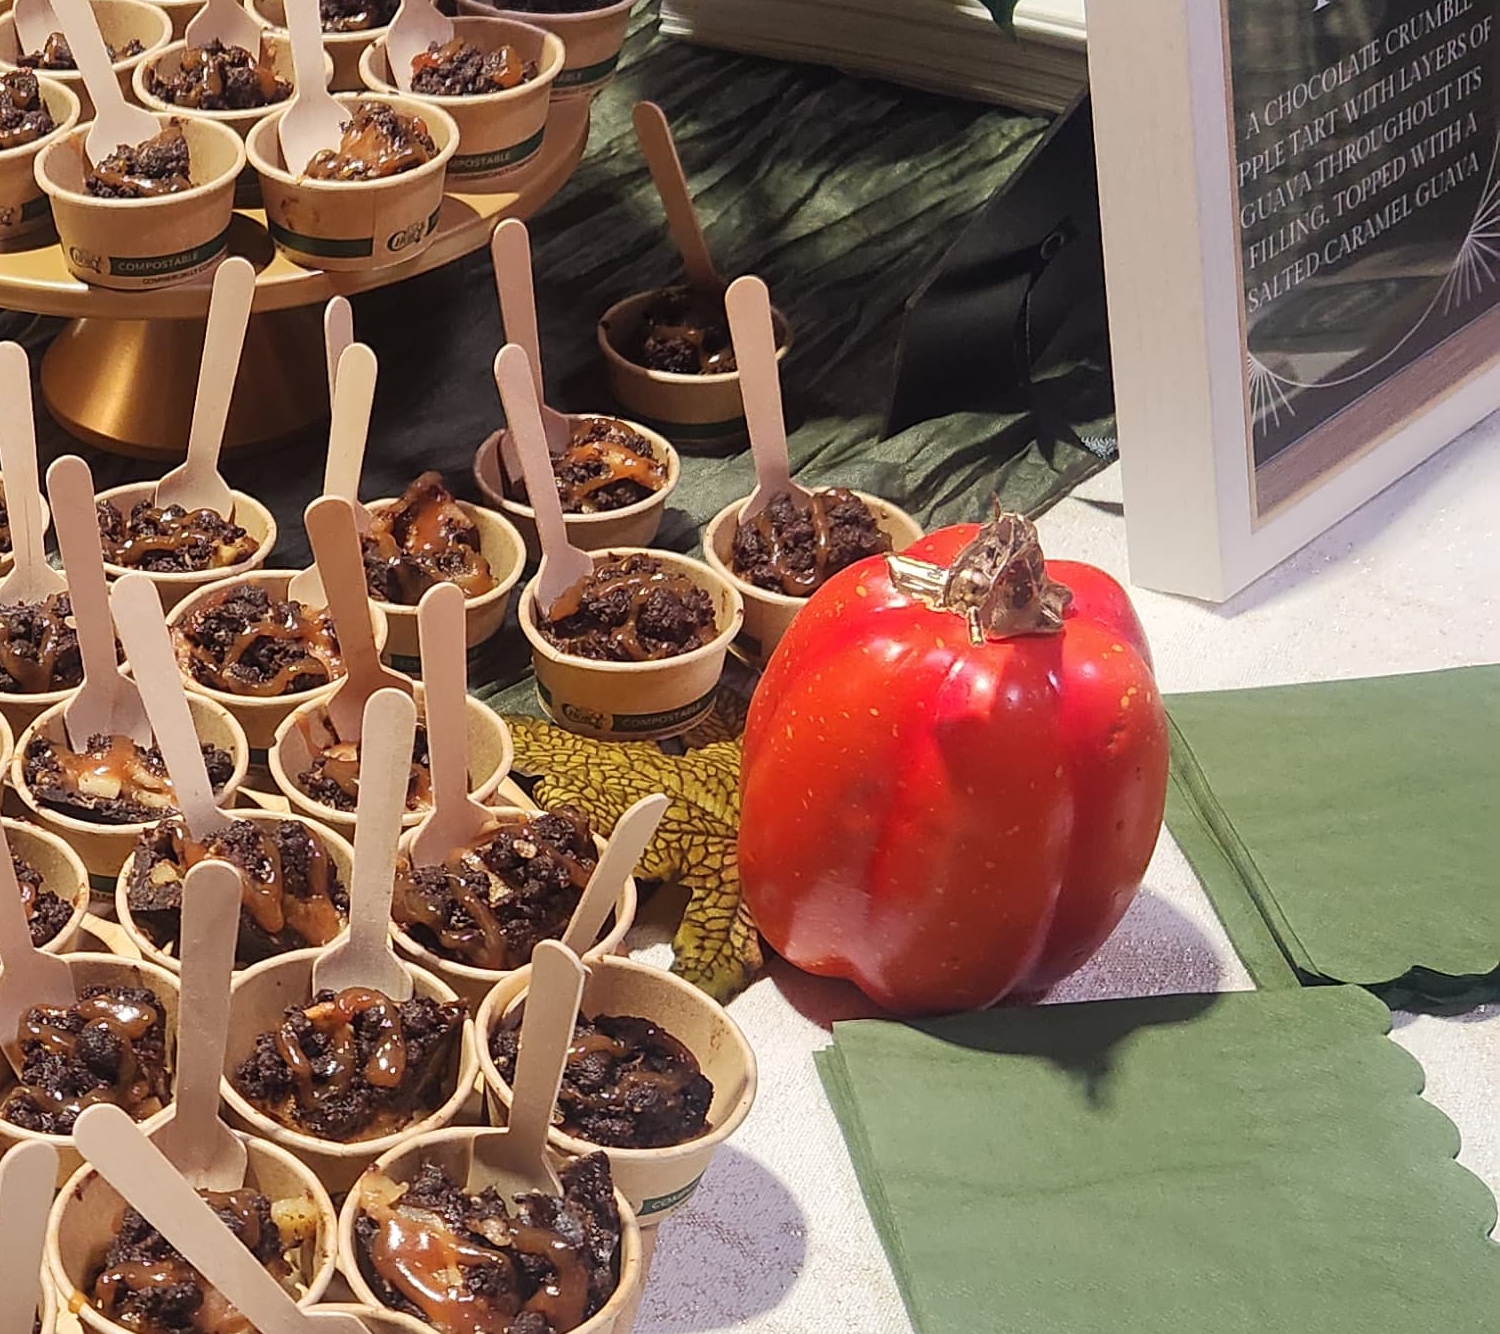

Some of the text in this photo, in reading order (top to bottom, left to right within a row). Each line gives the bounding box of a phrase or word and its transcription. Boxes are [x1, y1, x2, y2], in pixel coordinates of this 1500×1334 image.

[1238, 15, 1493, 187] PPLE TART WITH LAYERS OF
[1240, 66, 1483, 229] GUAVA THROUGHOUT ITS
[1245, 110, 1261, 140] A
[1264, 38, 1383, 127] CHOCOLATE
[1332, 155, 1407, 216] TOPPED
[1410, 119, 1462, 169] WITH
[1465, 112, 1478, 135] A
[1248, 151, 1480, 313] SALTED CARAMEL GUAVA
